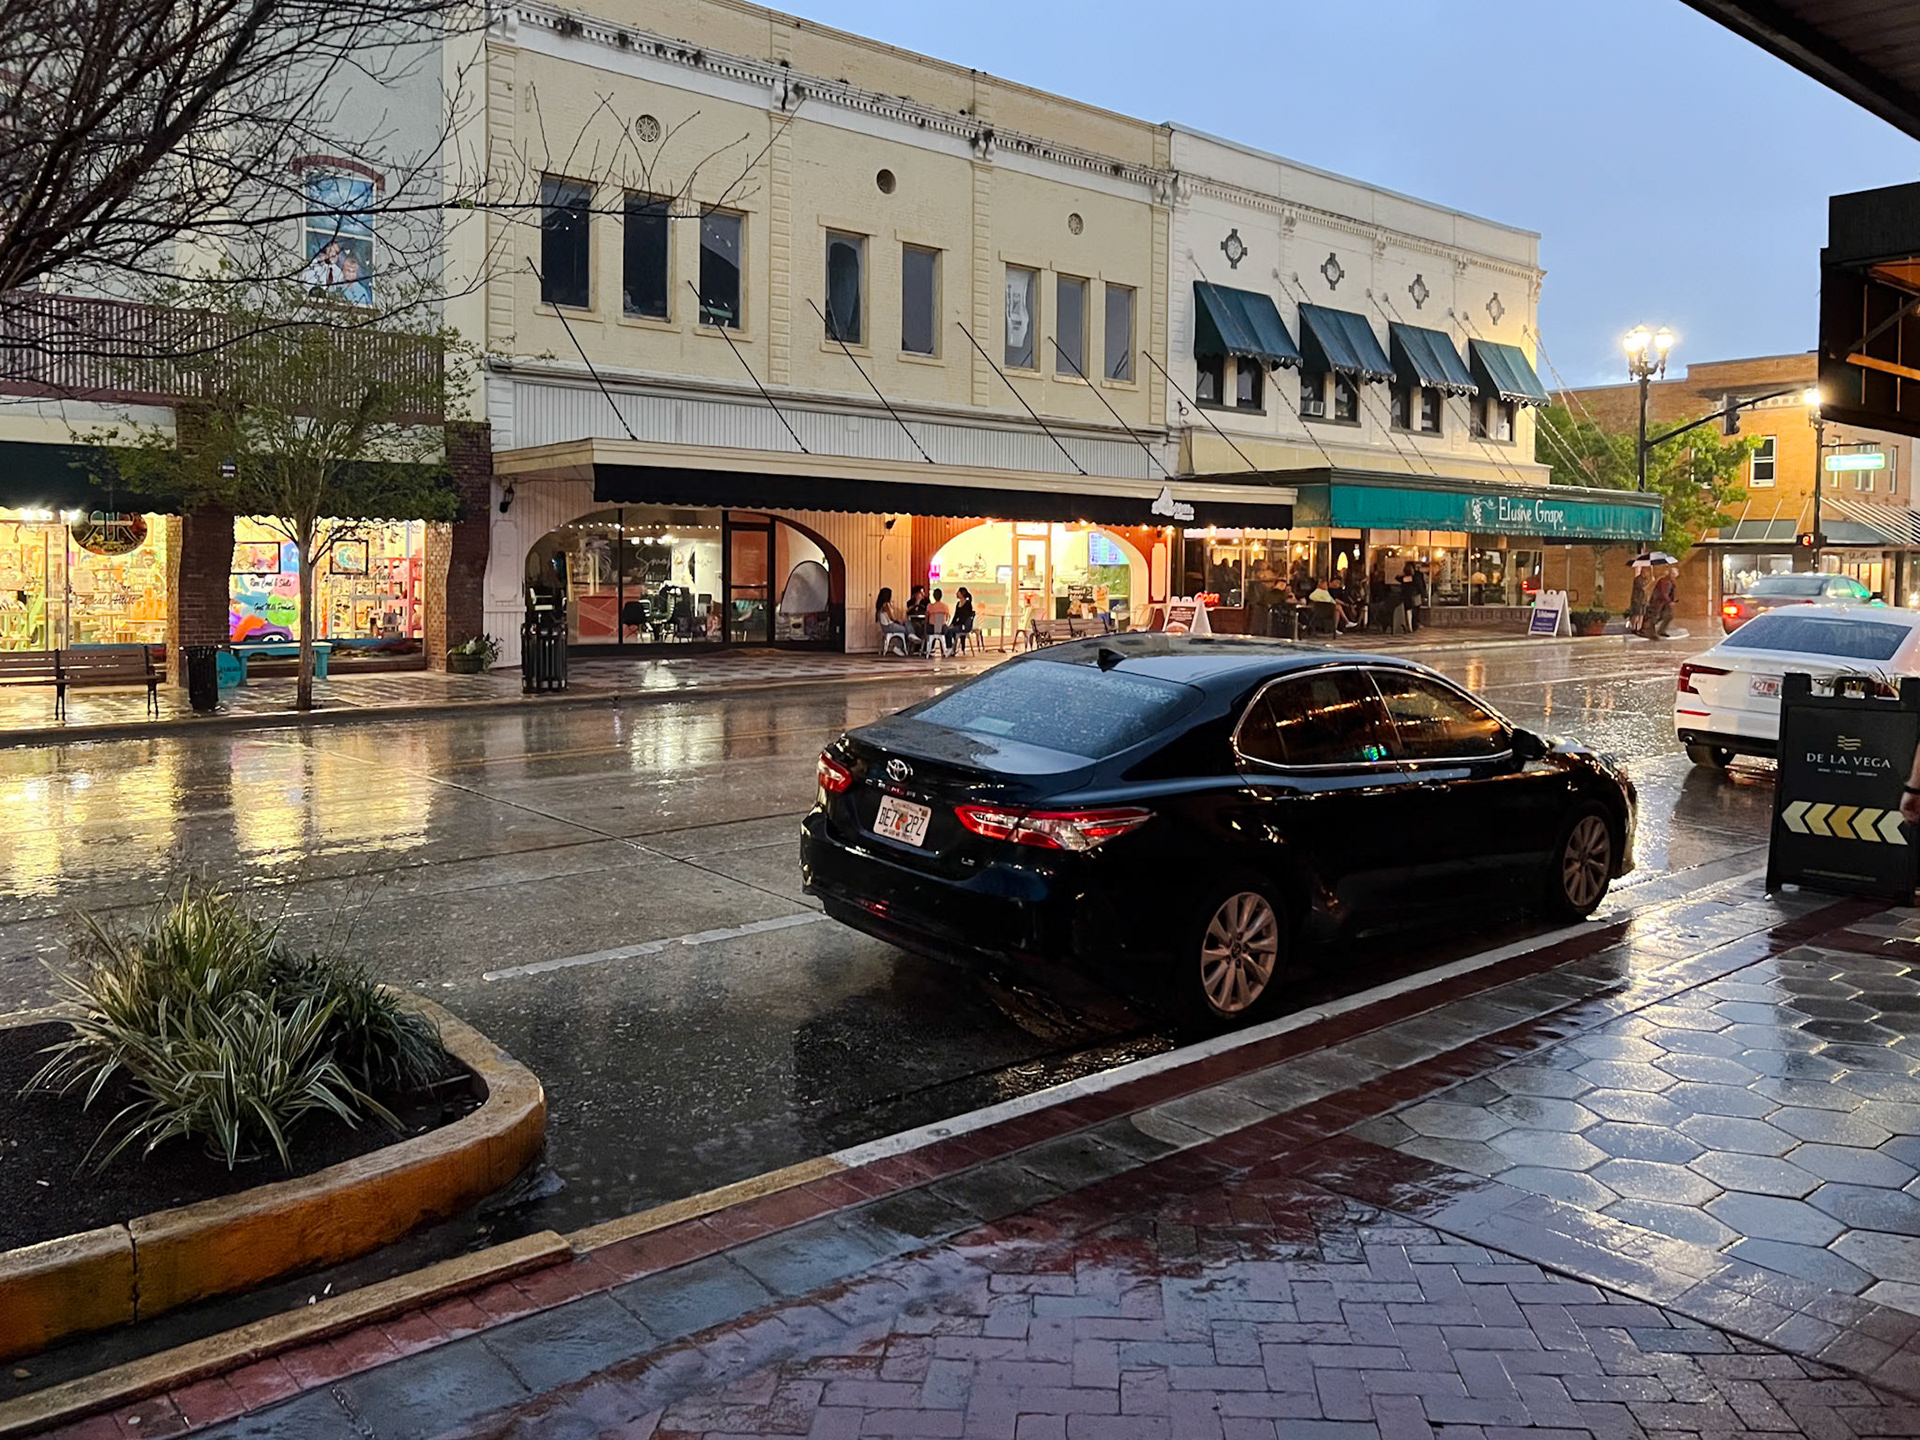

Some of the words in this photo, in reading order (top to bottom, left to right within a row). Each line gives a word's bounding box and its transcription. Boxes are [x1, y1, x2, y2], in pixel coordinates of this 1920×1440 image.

[1498, 496, 1532, 522] Elusive
[1535, 499, 1564, 530] Grape
[1806, 752, 1824, 763] DE
[1830, 754, 1847, 765] LA
[1853, 755, 1891, 769] VEGA
